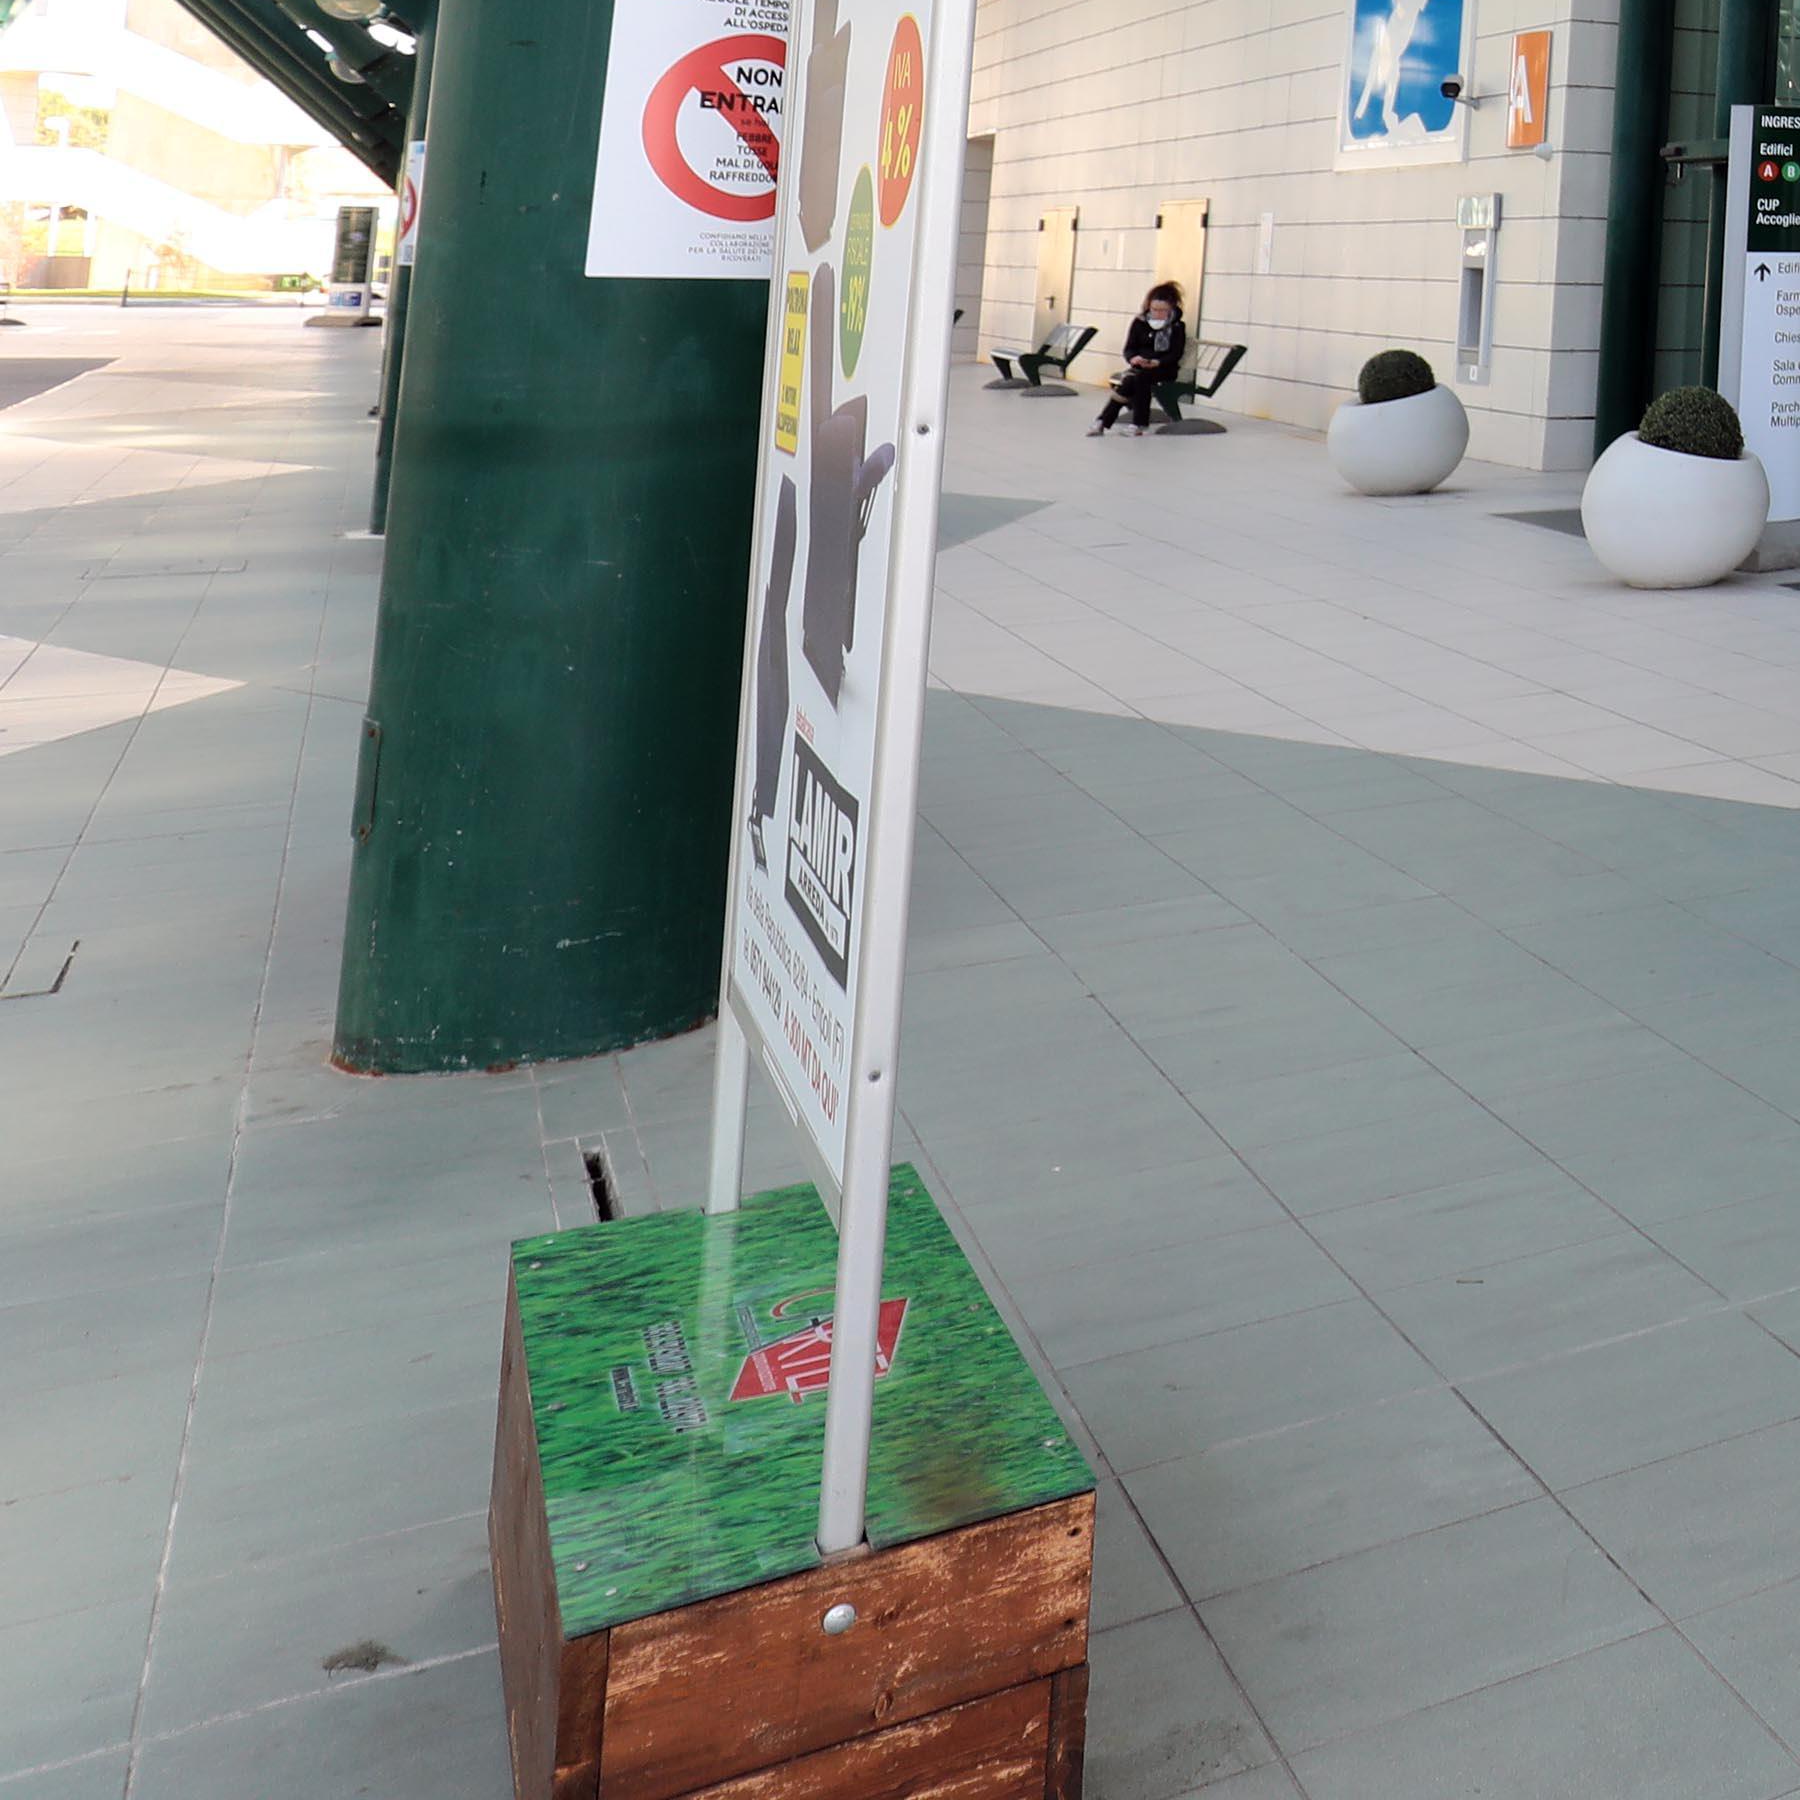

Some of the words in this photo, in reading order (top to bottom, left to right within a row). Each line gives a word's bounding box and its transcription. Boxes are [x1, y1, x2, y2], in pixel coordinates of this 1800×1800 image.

[734, 7, 747, 16] DI
[750, 8, 789, 22] ACCESS
[724, 17, 788, 33] ALL'OSPEDA
[736, 66, 783, 88] NON
[893, 51, 912, 88] IVA
[1508, 55, 1533, 124] A
[700, 91, 783, 114] ENTRA
[881, 103, 913, 180] 4%
[1760, 143, 1793, 156] Edifici
[738, 146, 768, 157] TOSSE
[716, 158, 740, 168] MAL
[743, 160, 754, 168] DI
[1763, 164, 1773, 177] A
[1787, 165, 1795, 178] B
[1757, 198, 1780, 211] CUP
[1773, 359, 1796, 371] Sala
[789, 752, 854, 921] LAMIR
[798, 865, 825, 926] ARREDA
